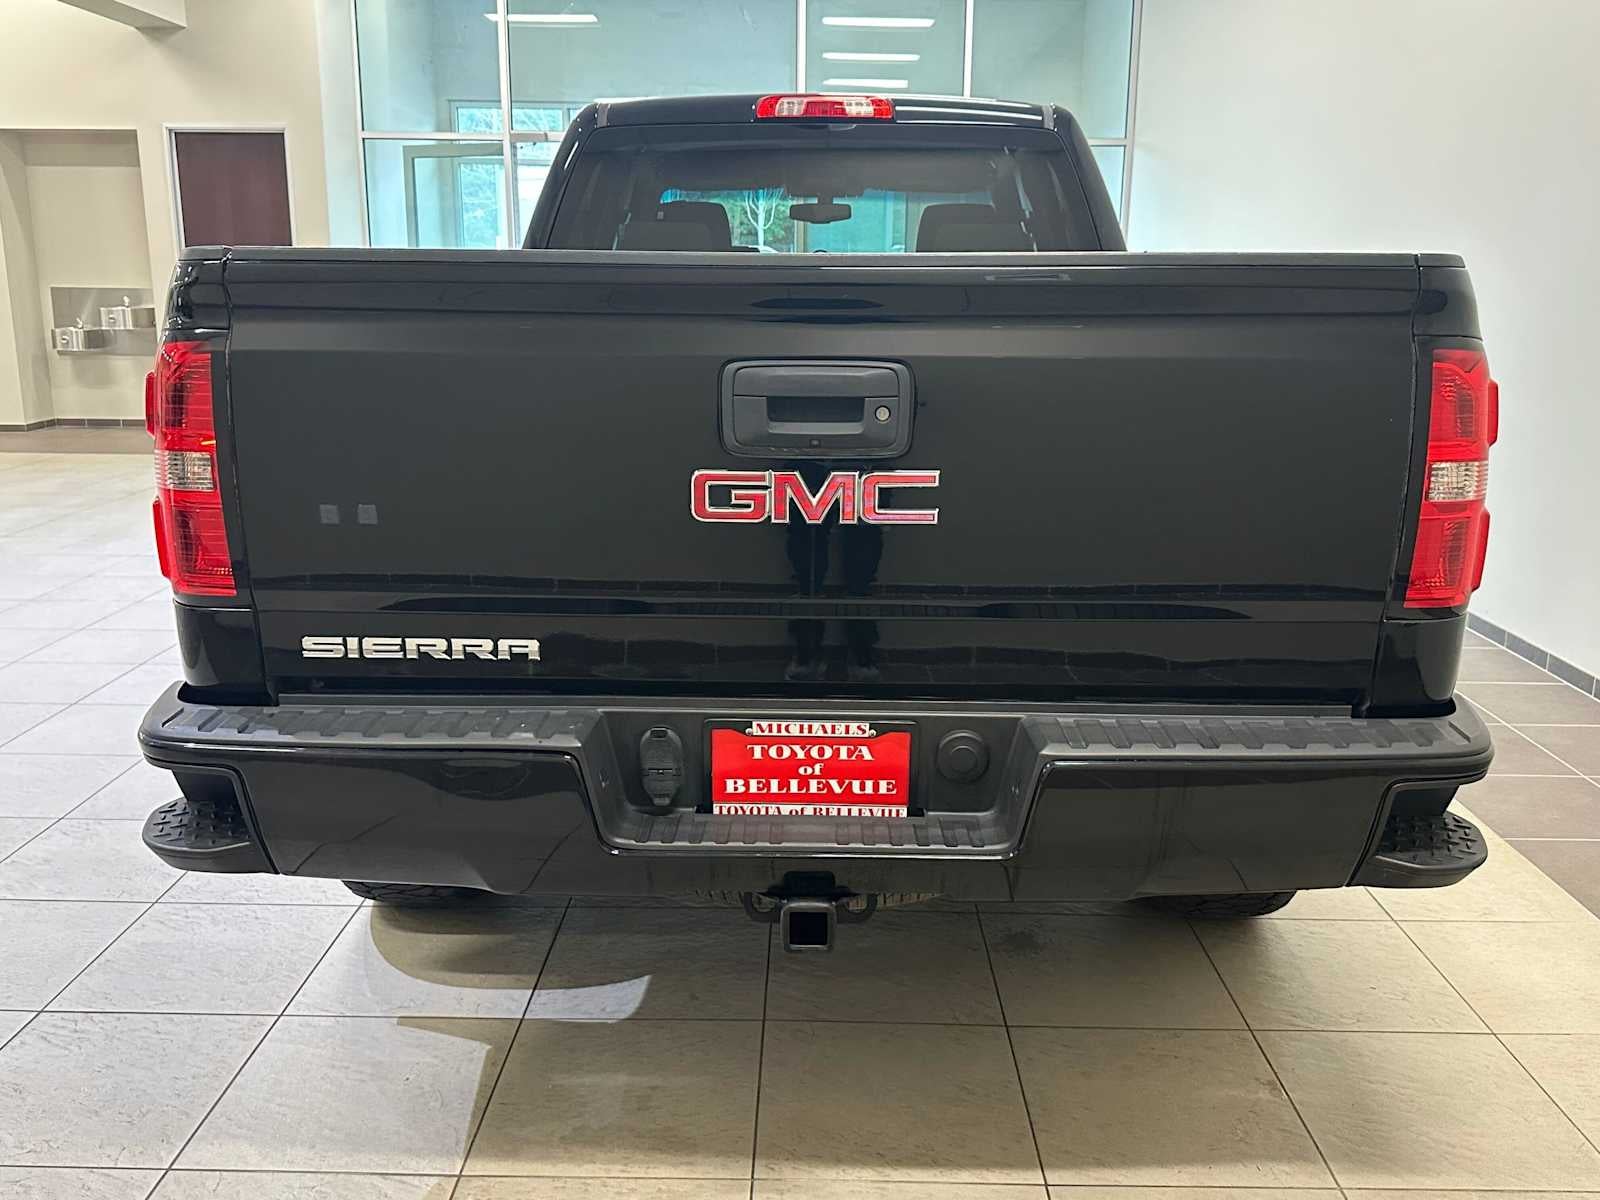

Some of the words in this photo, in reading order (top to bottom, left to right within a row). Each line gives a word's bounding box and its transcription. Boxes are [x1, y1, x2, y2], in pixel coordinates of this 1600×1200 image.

[691, 470, 941, 525] GMC
[301, 635, 541, 661] SIERRA
[755, 722, 867, 736] MICHAELS
[747, 744, 875, 761] TOYOTA
[798, 763, 824, 776] of
[724, 778, 897, 795] BELLEVUE
